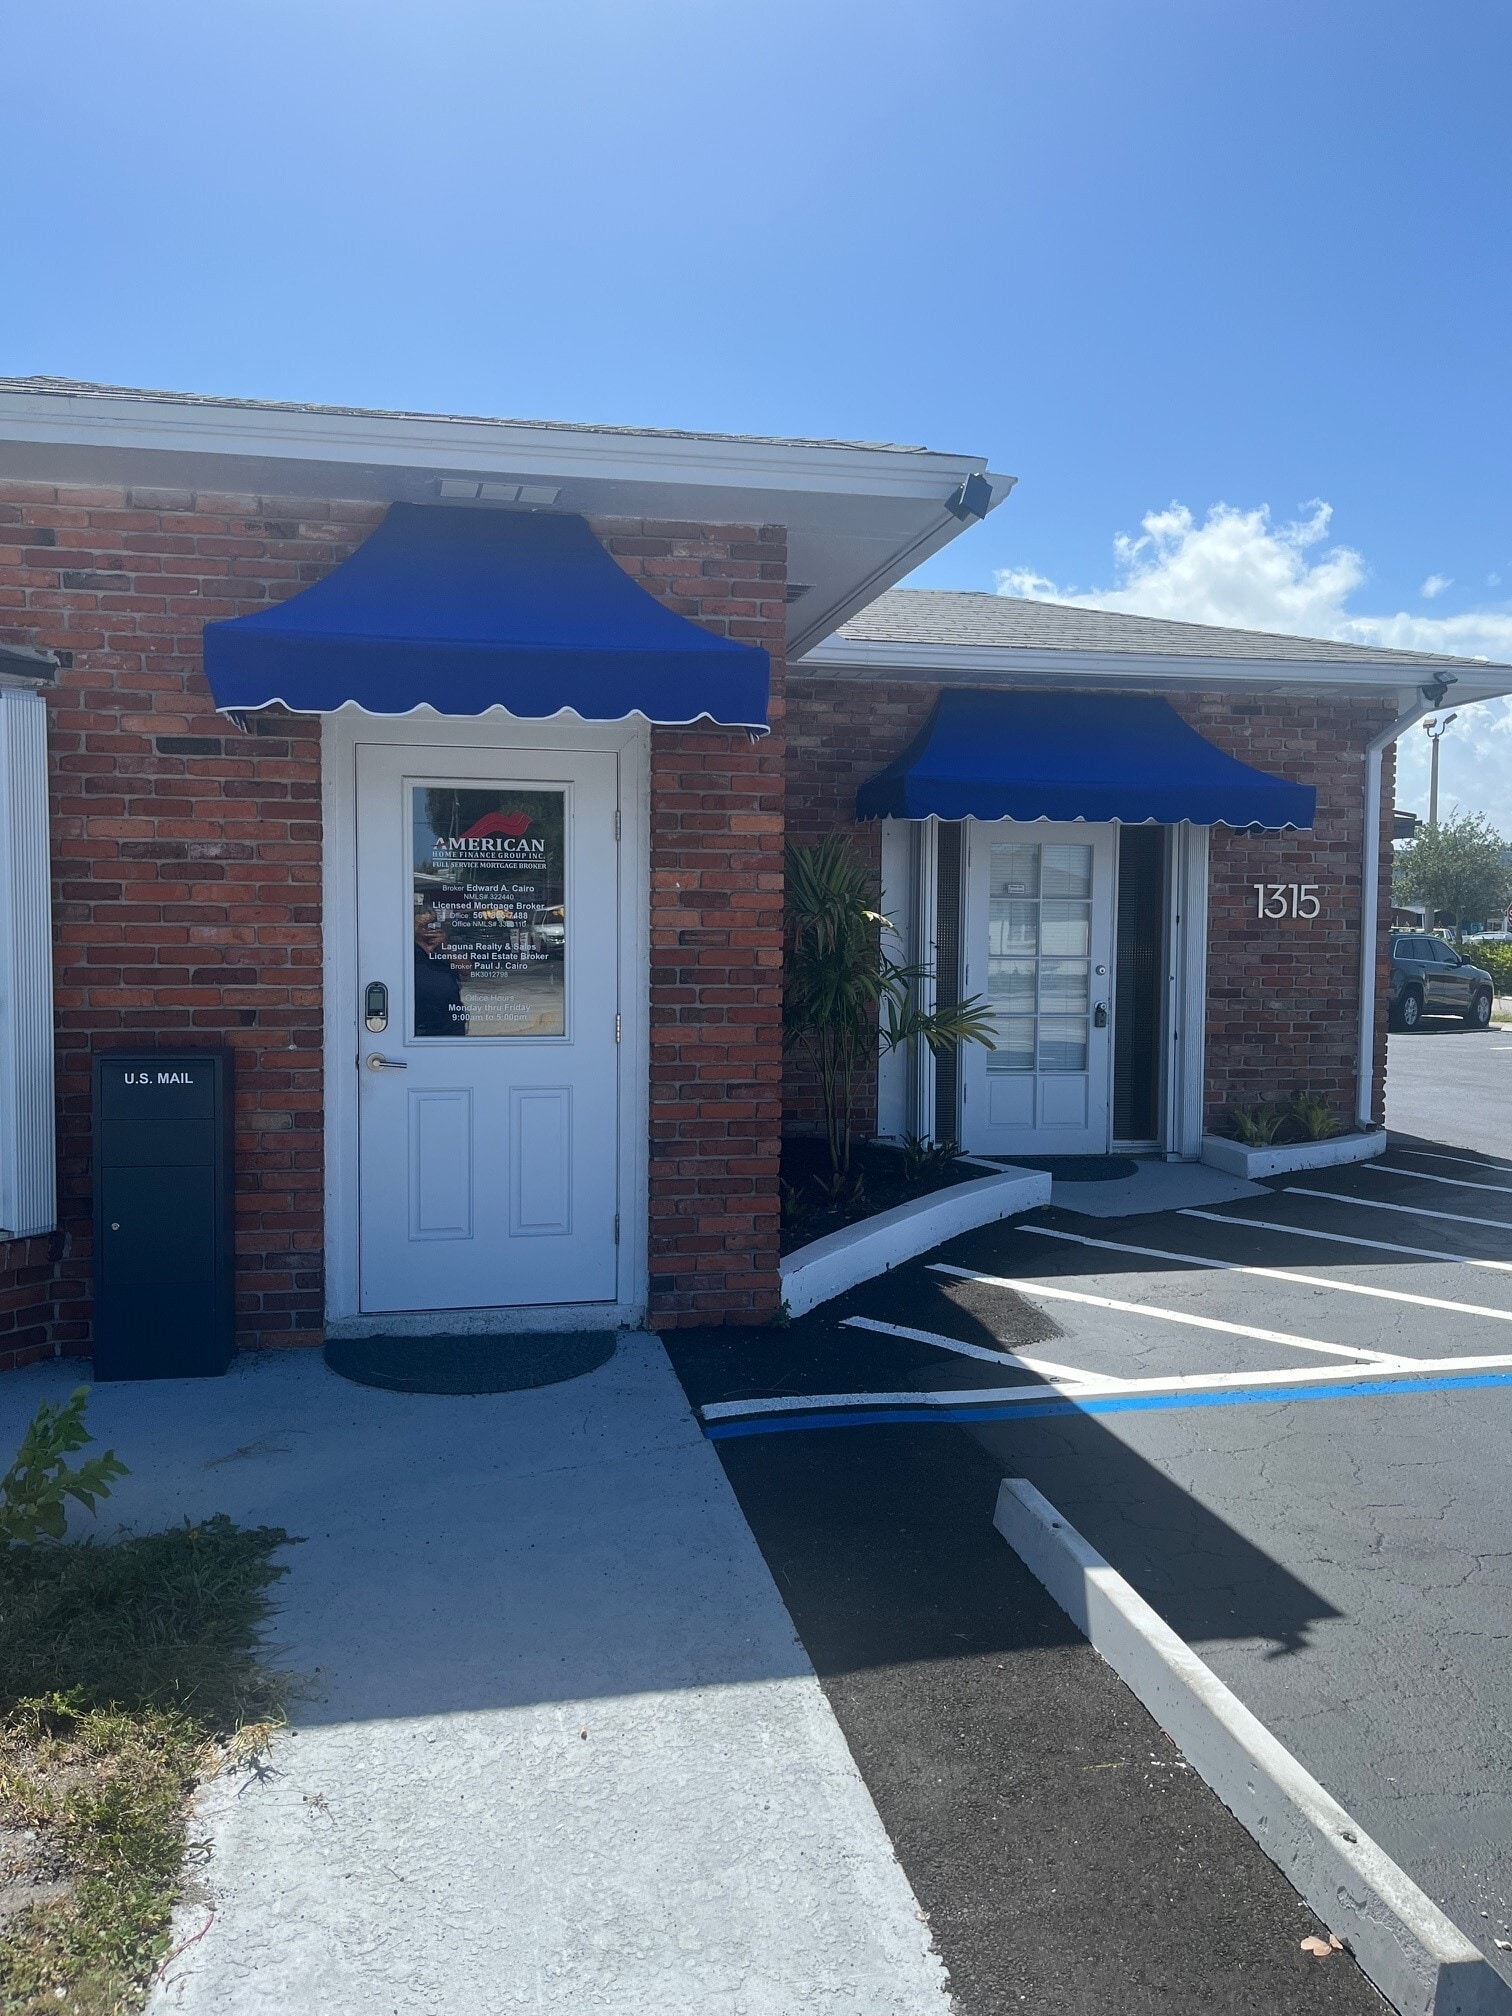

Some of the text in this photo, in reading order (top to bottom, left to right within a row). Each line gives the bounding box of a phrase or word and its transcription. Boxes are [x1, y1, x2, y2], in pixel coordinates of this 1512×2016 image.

[433, 837, 545, 851] AMERICAN
[467, 884, 498, 892] Edward
[1253, 883, 1320, 919] 1315
[474, 902, 513, 910] Mortgage
[441, 943, 473, 951] Laguna
[476, 943, 502, 951] Realty
[448, 1004, 481, 1012] Monday
[504, 1004, 530, 1012] Friday
[124, 1072, 194, 1085] U.S. MAIL
